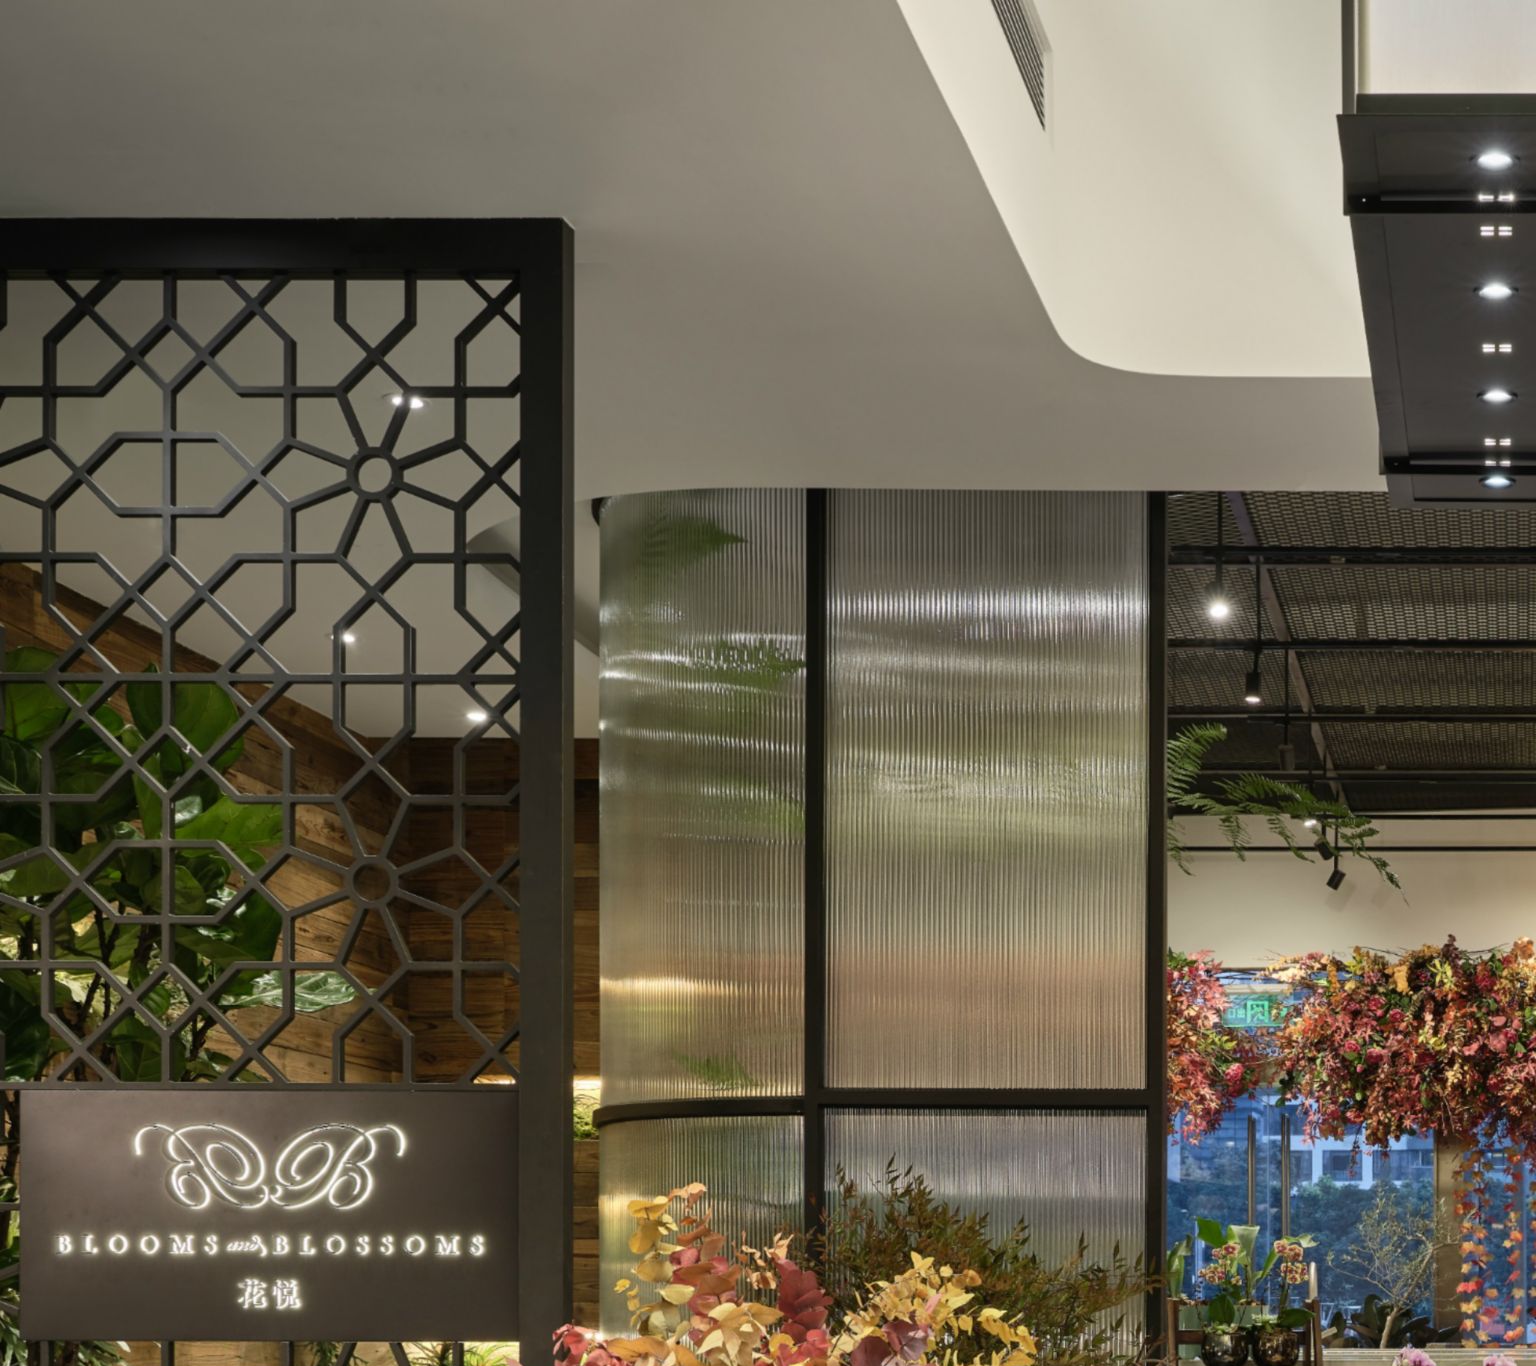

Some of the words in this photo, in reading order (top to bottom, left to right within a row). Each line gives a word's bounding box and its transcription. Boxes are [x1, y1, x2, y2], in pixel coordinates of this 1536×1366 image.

[56, 1233, 219, 1255] BLOOMS
[226, 1235, 268, 1257] and
[272, 1234, 486, 1256] BLOSSOMS
[237, 1278, 302, 1309] 花悦
